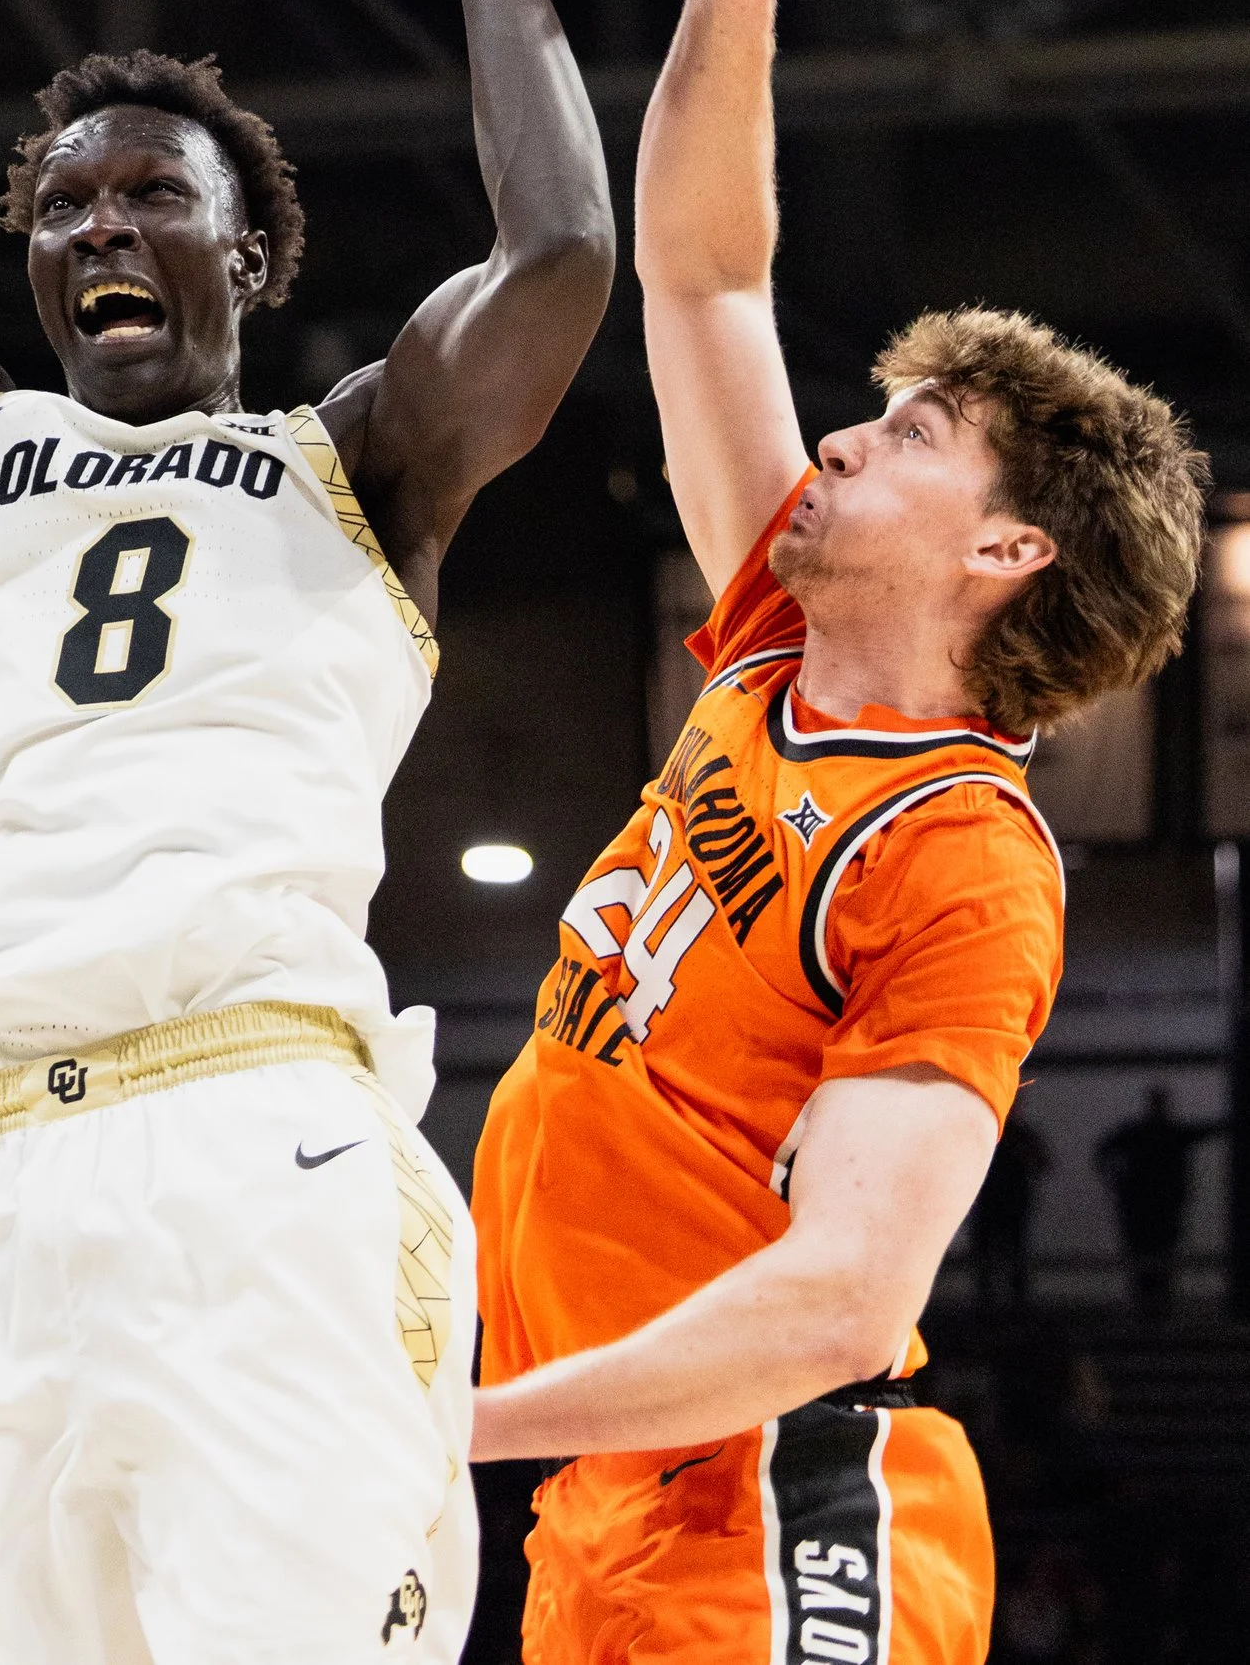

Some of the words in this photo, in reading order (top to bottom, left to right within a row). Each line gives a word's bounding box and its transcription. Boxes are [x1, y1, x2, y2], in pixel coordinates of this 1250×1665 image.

[48, 513, 195, 711] 8
[561, 806, 716, 1045] 24
[538, 957, 639, 1067] STATE
[48, 1058, 88, 1104] CU
[794, 1539, 870, 1665] OYS
